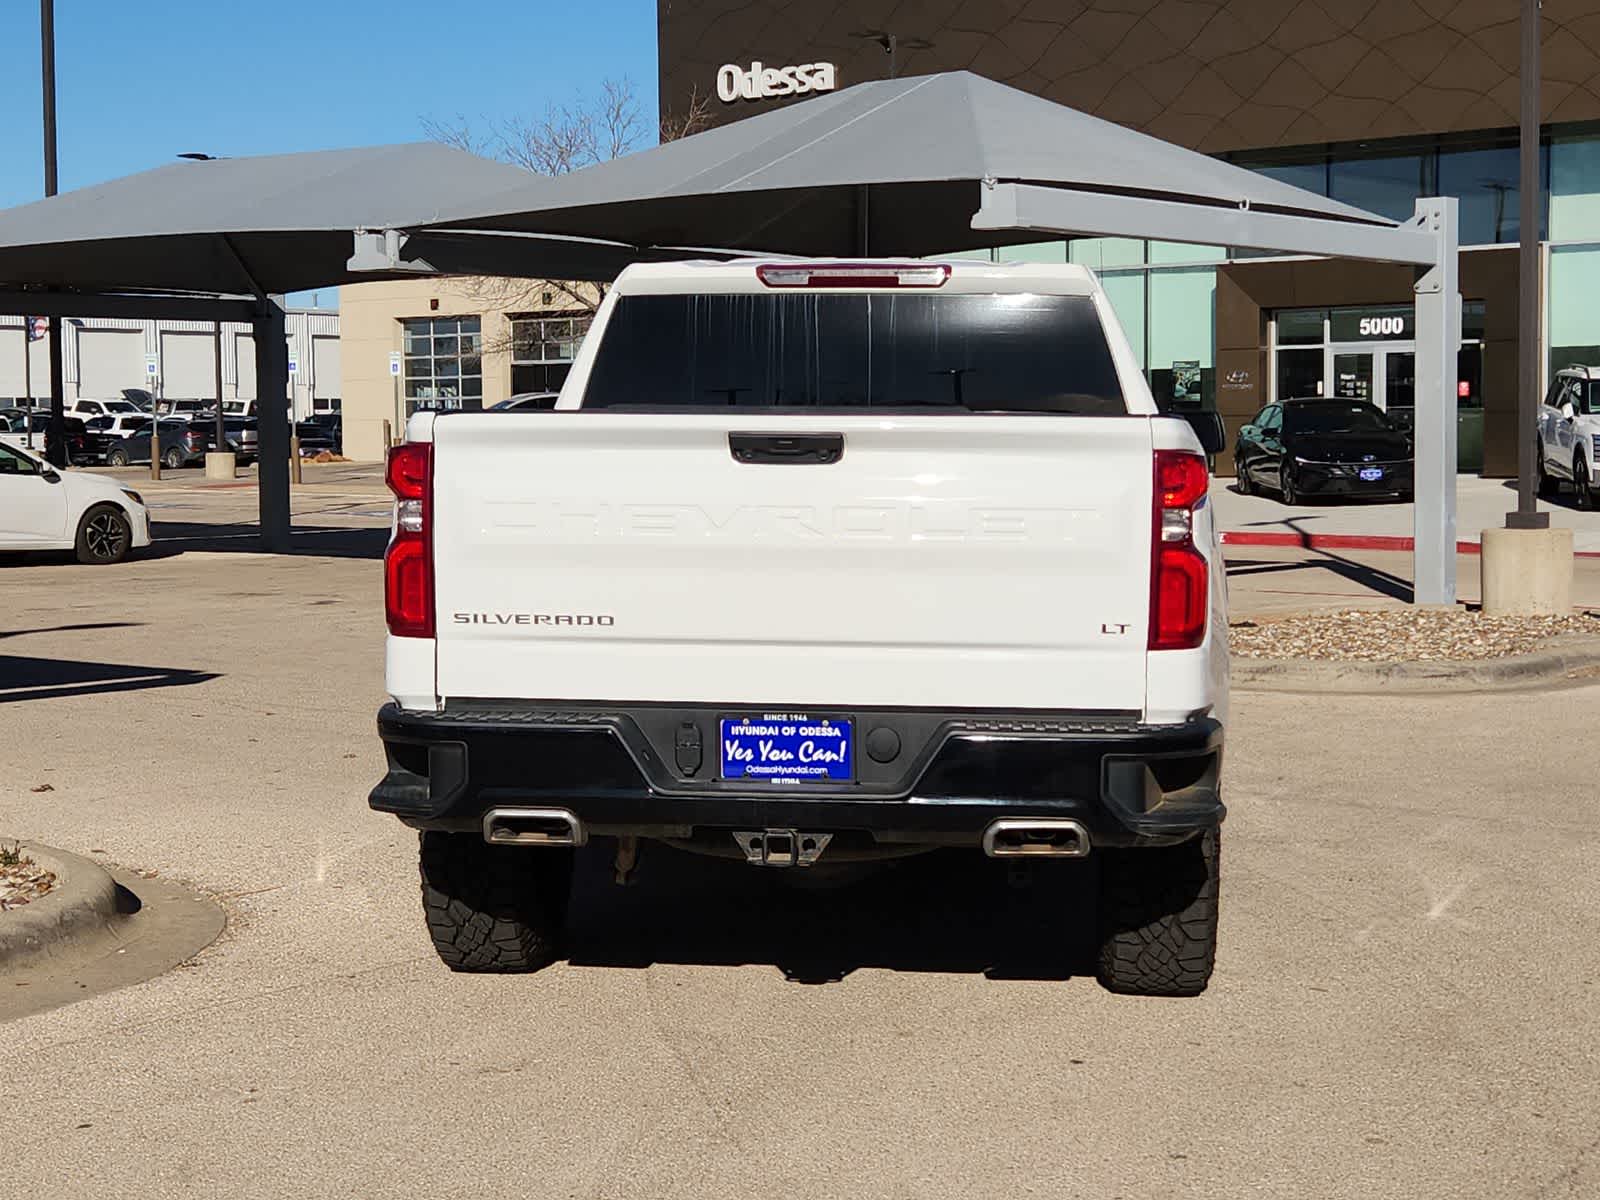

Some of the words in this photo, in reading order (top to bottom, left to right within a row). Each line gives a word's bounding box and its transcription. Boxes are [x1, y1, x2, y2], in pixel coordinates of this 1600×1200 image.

[717, 61, 835, 102] Odessa
[1359, 317, 1404, 335] 5000
[478, 498, 1104, 542] CHEVROLET
[453, 612, 615, 626] SILVERADO
[1101, 623, 1132, 634] LT
[731, 726, 779, 736] HYUNDAI
[781, 726, 797, 737] OF
[799, 727, 842, 737] ODESSA
[725, 740, 755, 762] Yes
[758, 740, 795, 762] You
[798, 740, 847, 763] Can!
[746, 765, 828, 775] OdessaHyundai.com
